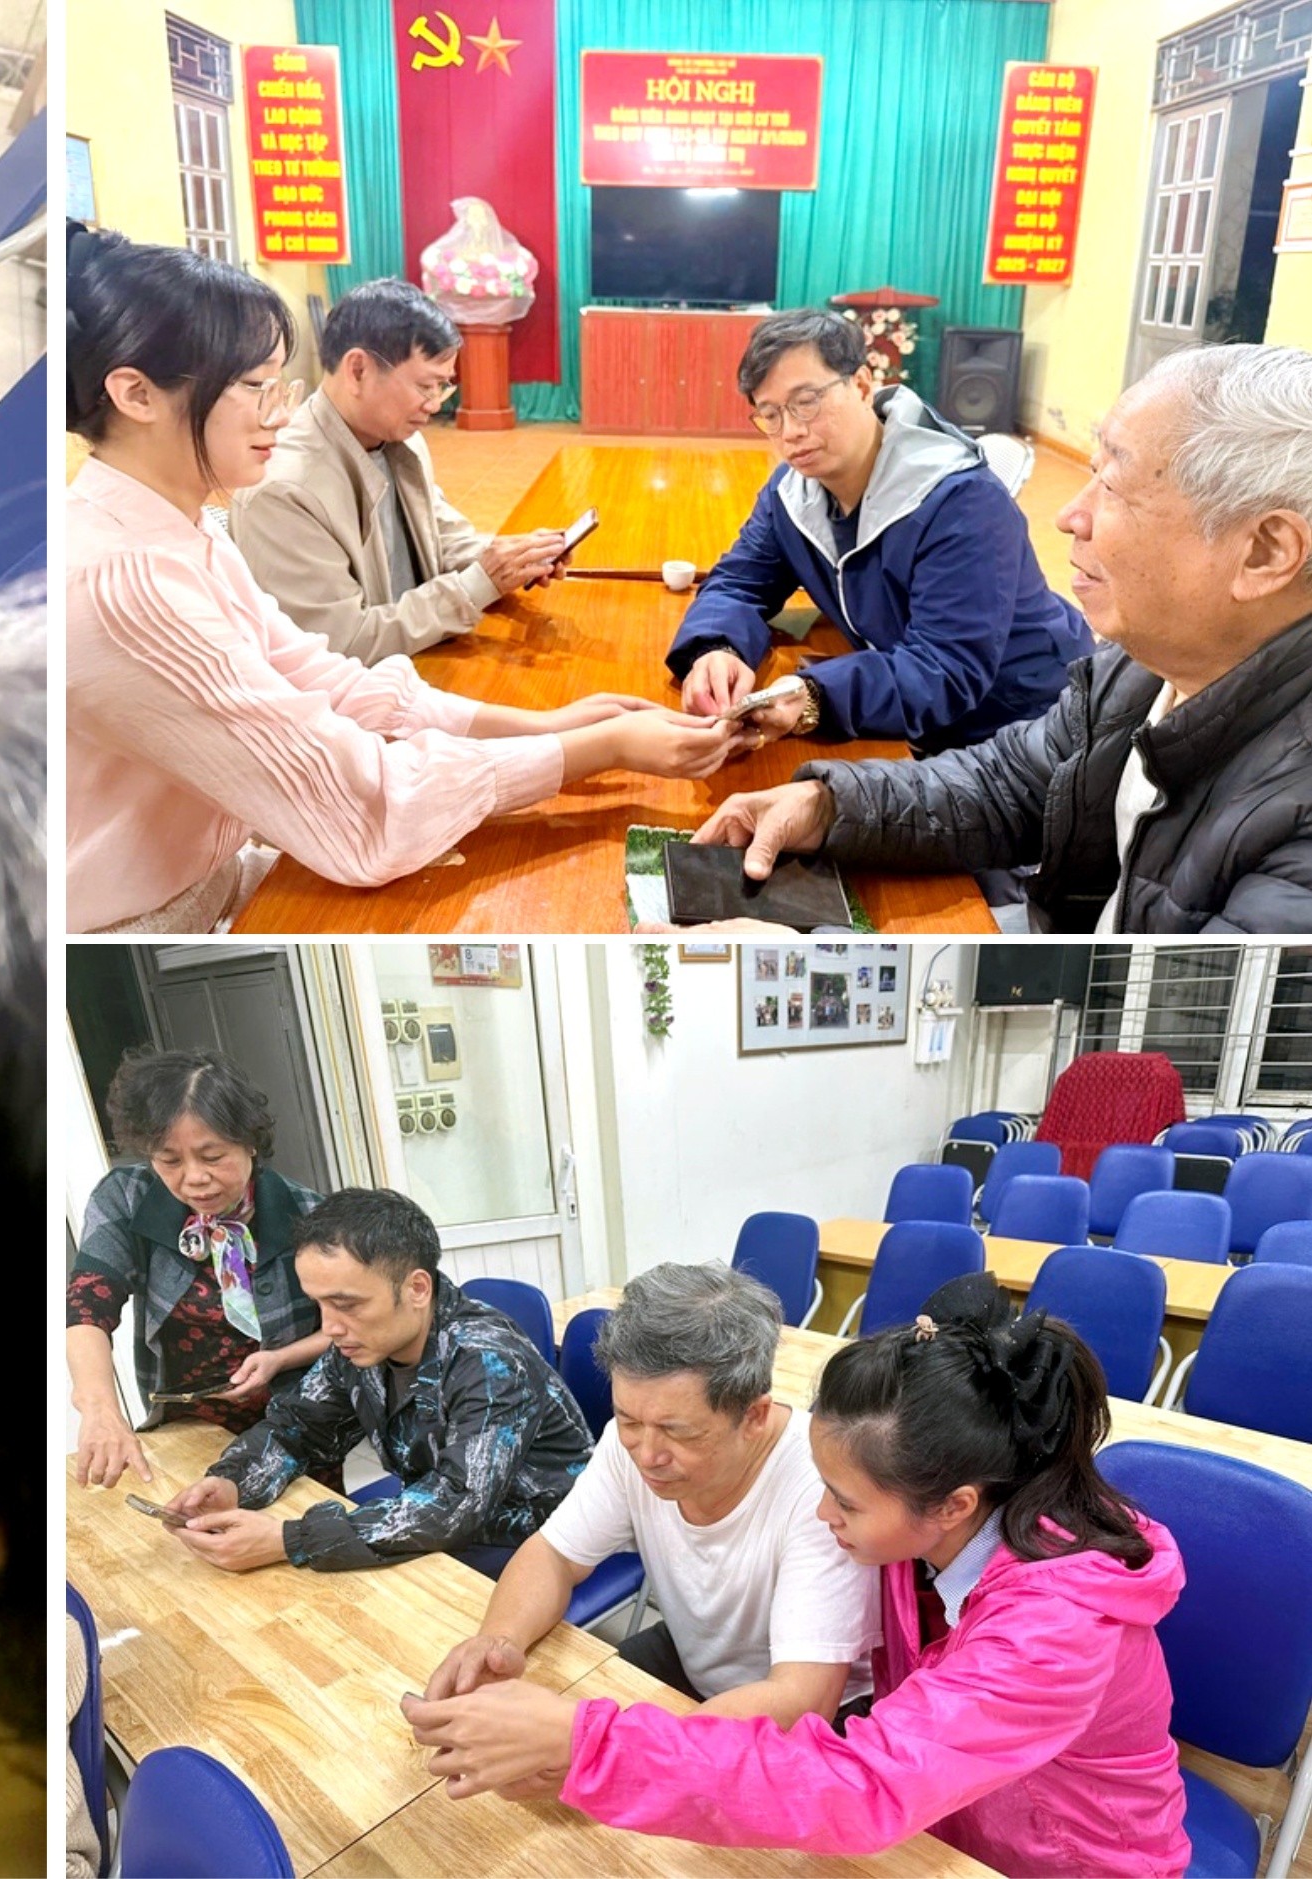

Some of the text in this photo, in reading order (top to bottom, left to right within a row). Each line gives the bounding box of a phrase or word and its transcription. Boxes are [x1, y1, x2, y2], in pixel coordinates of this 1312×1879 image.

[646, 75, 756, 107] HỘI NGHỊ
[264, 107, 287, 124] LAO
[260, 130, 277, 151] VÀ
[253, 159, 282, 176] THEO
